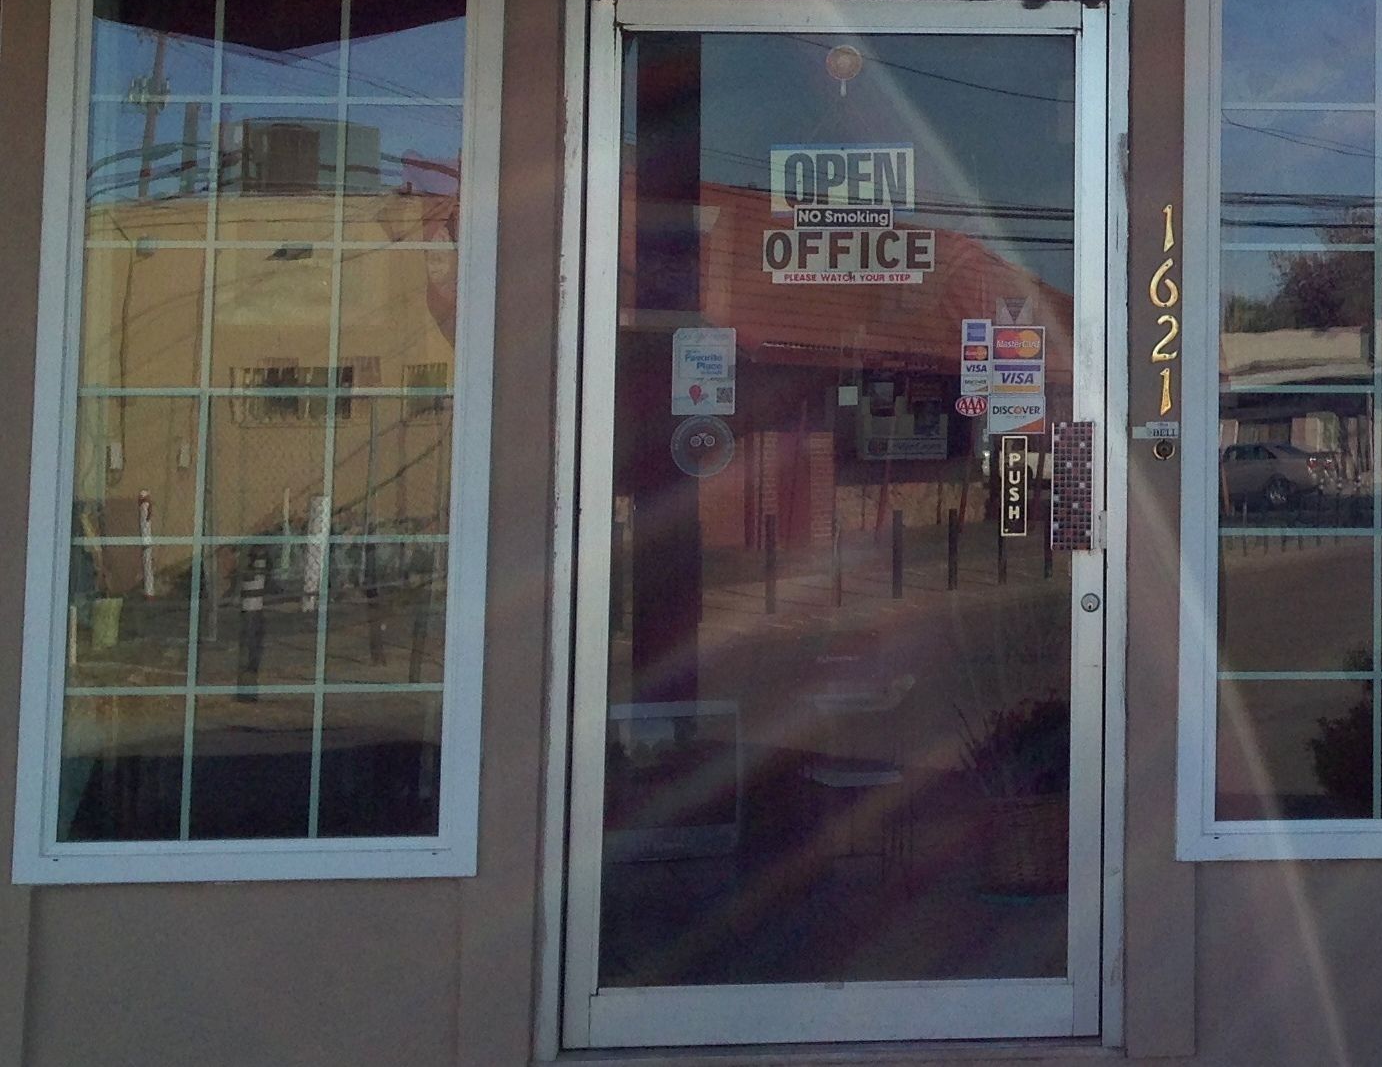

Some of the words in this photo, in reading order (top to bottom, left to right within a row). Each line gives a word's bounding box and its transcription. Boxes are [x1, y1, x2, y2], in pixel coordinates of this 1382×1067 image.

[784, 152, 907, 208] OPEN
[798, 210, 821, 223] NO
[825, 210, 889, 226] Smoking
[765, 231, 932, 270] OFFICE
[784, 273, 816, 282] PLEASE
[821, 273, 855, 282] WATCH
[860, 273, 885, 282] YOUR
[889, 273, 911, 282] STEP
[1150, 204, 1179, 416] 1621
[996, 339, 1041, 349] MasterCard
[966, 364, 988, 373] VISA
[1001, 372, 1034, 385] VISA
[960, 398, 987, 413] AAA
[992, 405, 1040, 415] DISCOVER
[1008, 452, 1021, 520] PUSH
